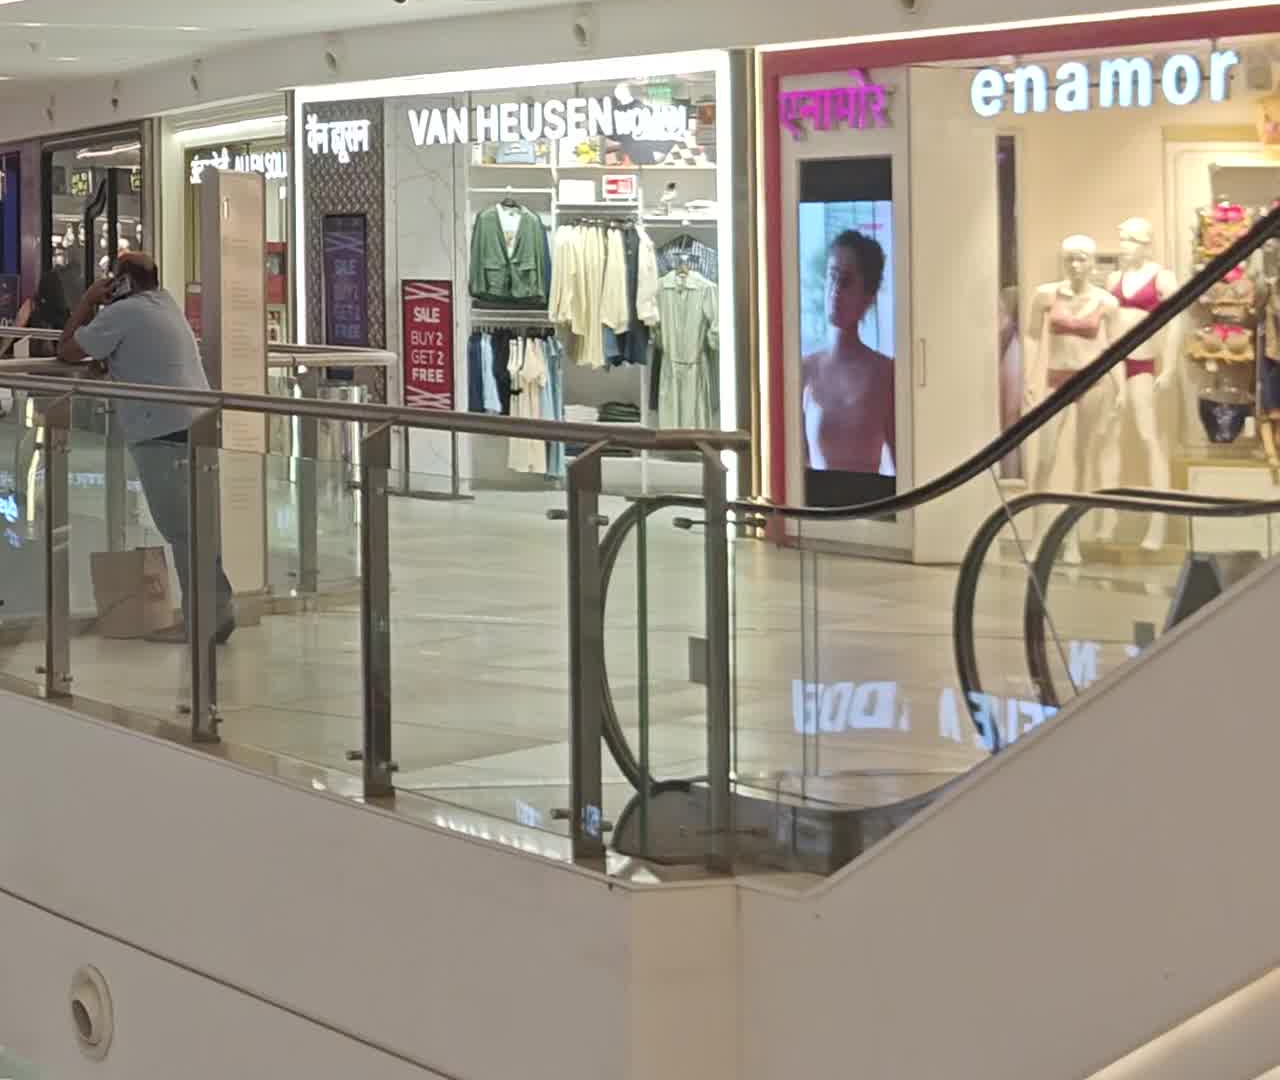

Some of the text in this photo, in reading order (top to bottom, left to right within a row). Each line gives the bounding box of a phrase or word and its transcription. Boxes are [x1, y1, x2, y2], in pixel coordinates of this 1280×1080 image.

[971, 50, 1238, 117] enamor
[408, 106, 469, 146] VAN
[476, 96, 612, 143] HEUSEN
[413, 307, 440, 323] SALE
[411, 331, 443, 346] BUY 2
[411, 350, 444, 366] GET 2
[412, 368, 444, 383] FREE
